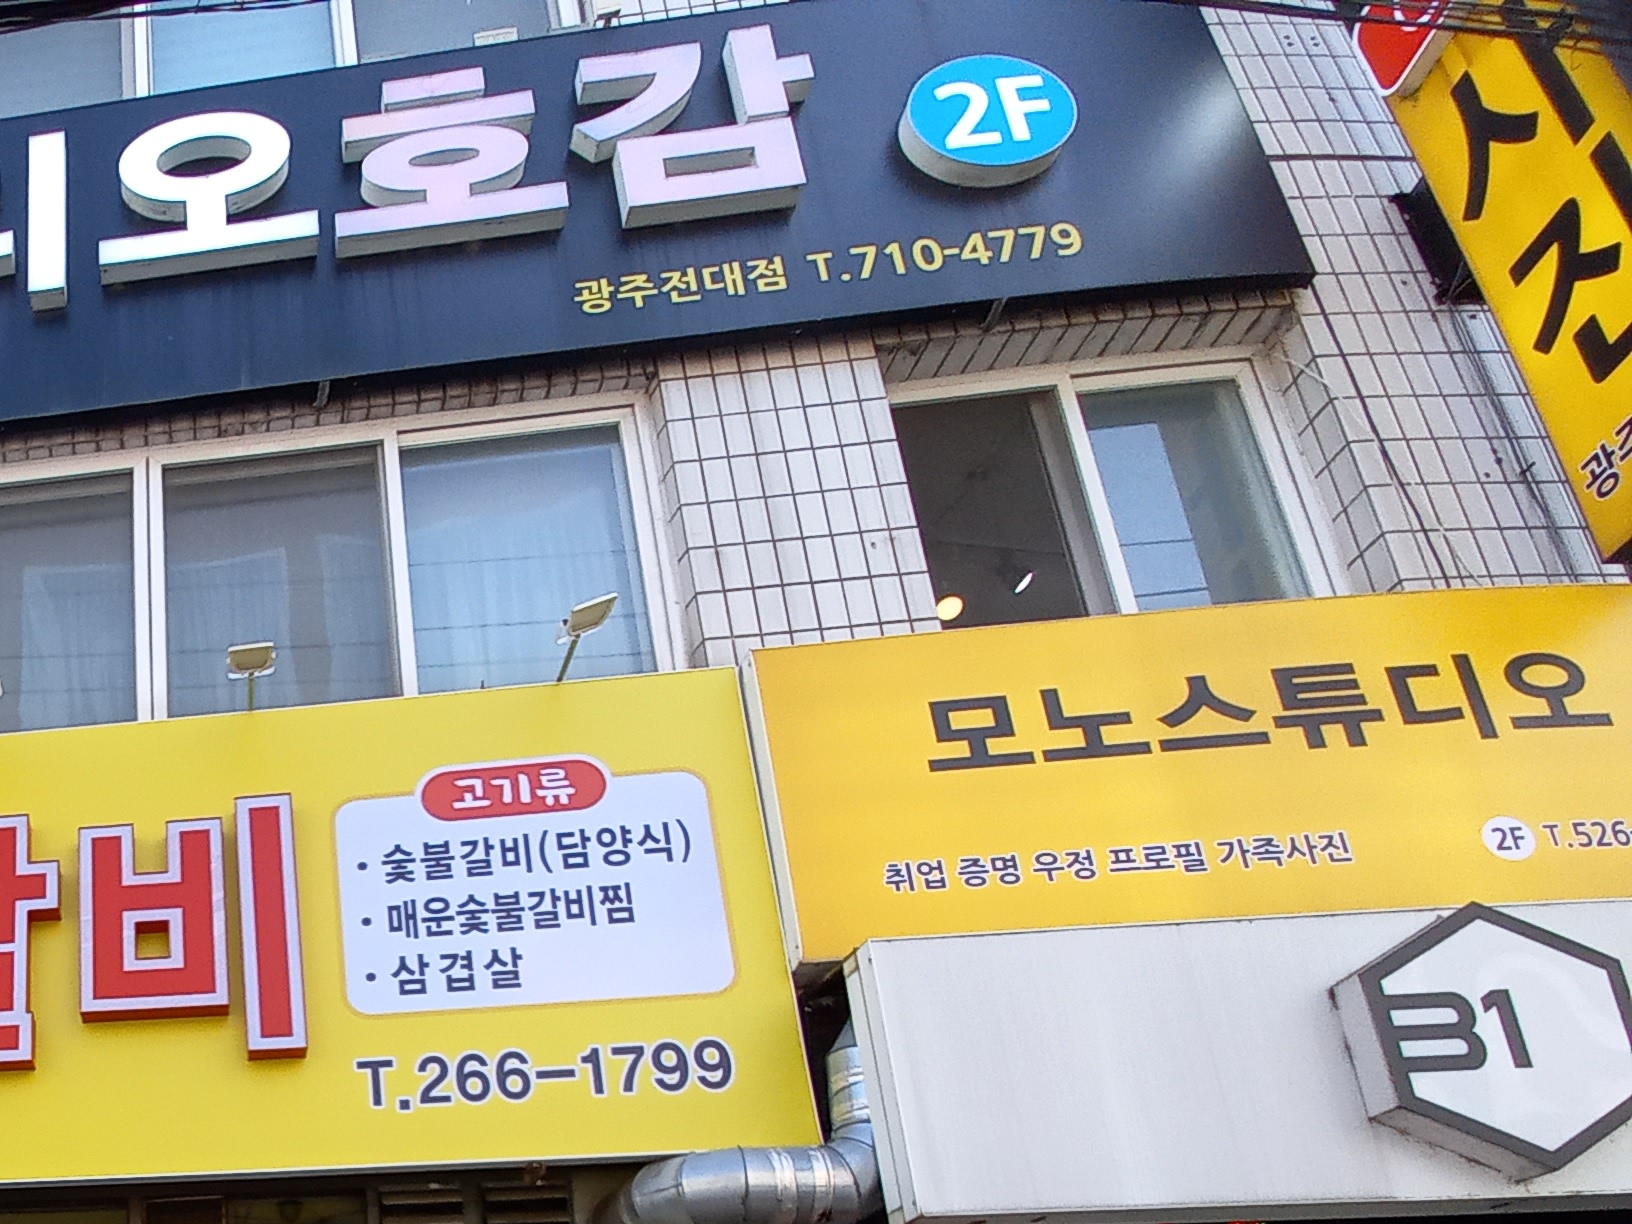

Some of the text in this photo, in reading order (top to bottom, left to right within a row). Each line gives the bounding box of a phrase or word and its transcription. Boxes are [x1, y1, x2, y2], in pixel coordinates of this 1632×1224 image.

[933, 74, 1051, 150] 2F
[573, 221, 1084, 315] 광주전대점 T.710-4779
[926, 650, 1614, 774] 모노스튜디오
[450, 765, 578, 812] 고기류
[883, 829, 1354, 896] 취업 증명 우정 프로필 가족사진
[1490, 820, 1632, 852] 2F T.526
[386, 881, 637, 941] 매운숯불갈비찜
[354, 1036, 736, 1115] T.266-1799
